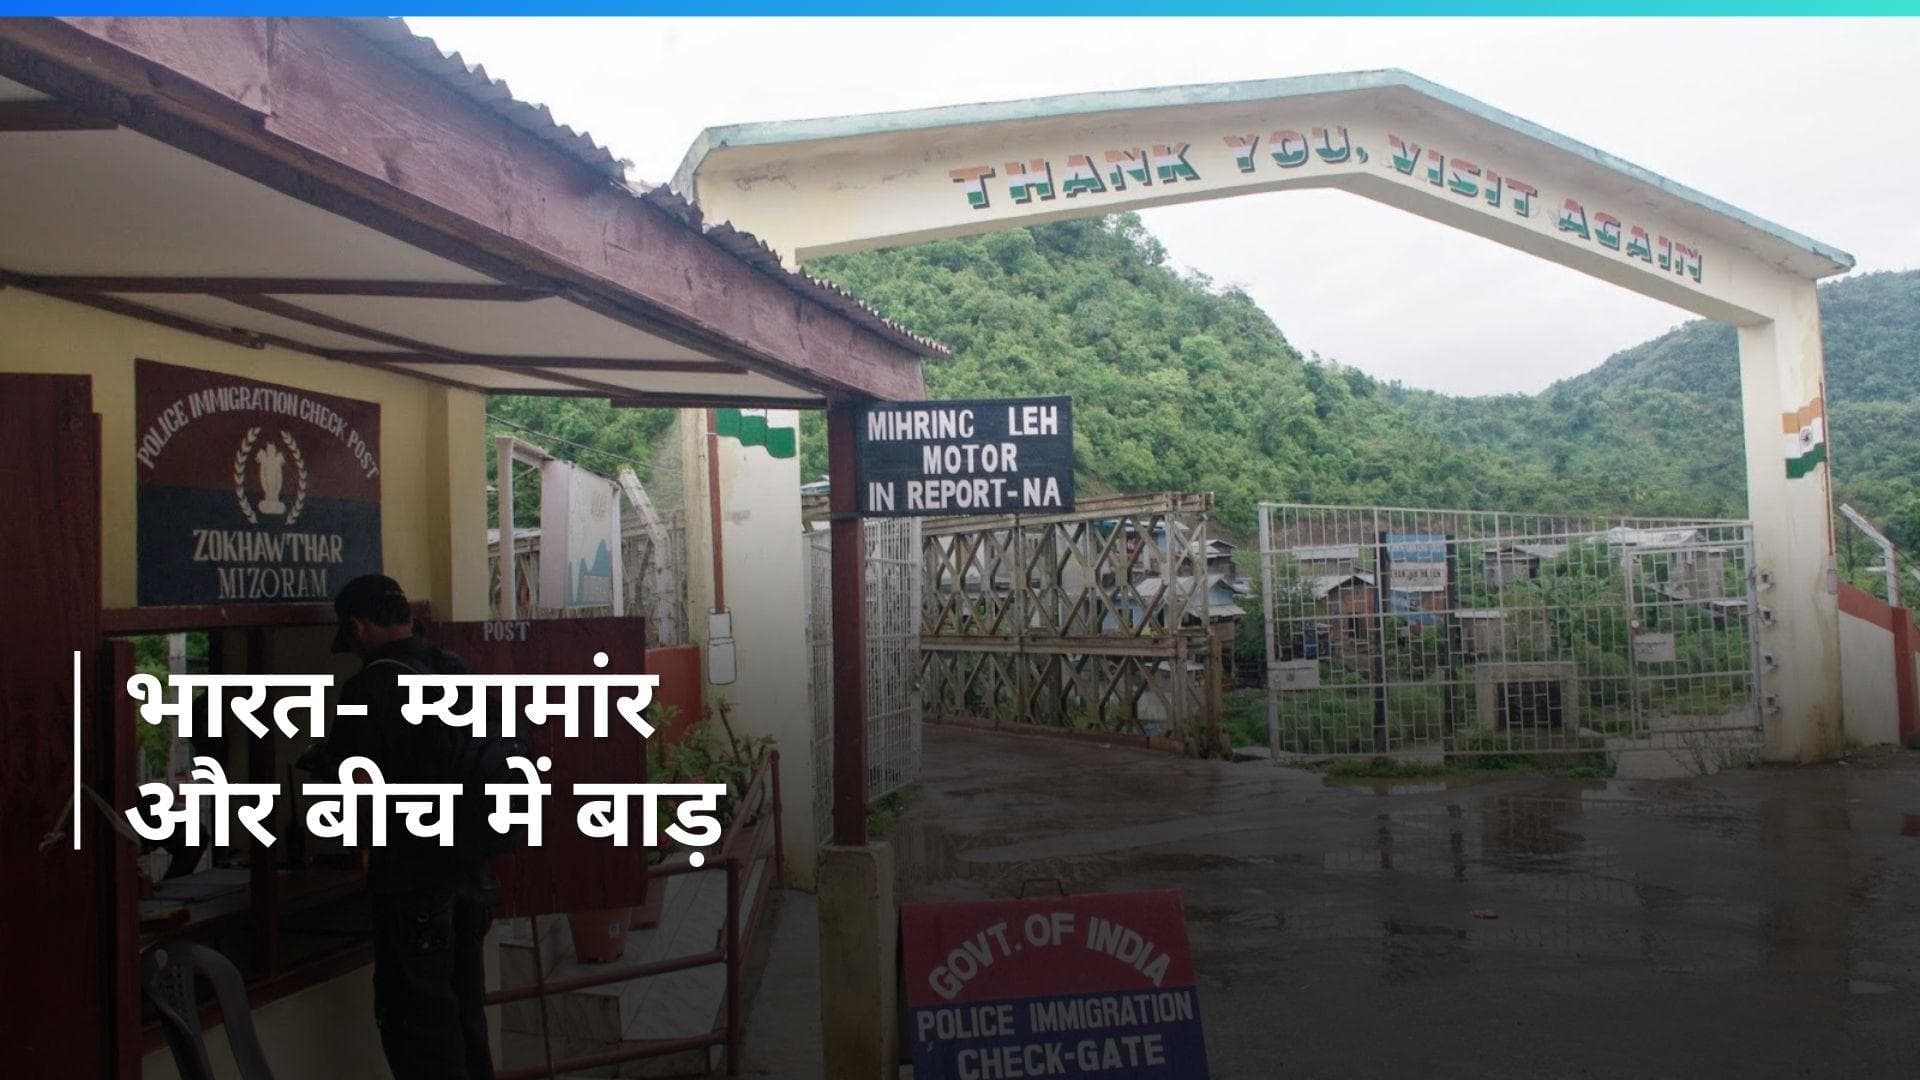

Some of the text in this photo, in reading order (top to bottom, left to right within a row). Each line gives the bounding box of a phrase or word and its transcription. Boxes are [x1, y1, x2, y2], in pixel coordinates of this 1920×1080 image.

[949, 125, 1702, 283] THANK YOU, VISIT AGAIN
[136, 386, 380, 480] POLICE IMMIGRATION CHECK POST
[1008, 405, 1058, 436] LEH
[922, 443, 1018, 475] MOTOR
[868, 476, 1062, 512] IN REPORT-NA
[192, 529, 343, 564] ZOKHAWTHAR
[218, 567, 328, 600] MIZORAM
[483, 621, 531, 642] POST
[928, 912, 1172, 1000] GOVT. OF INDIA
[916, 990, 1194, 1043] POLICE IMMIGRATION
[956, 1034, 1167, 1080] CHECK-GATE
